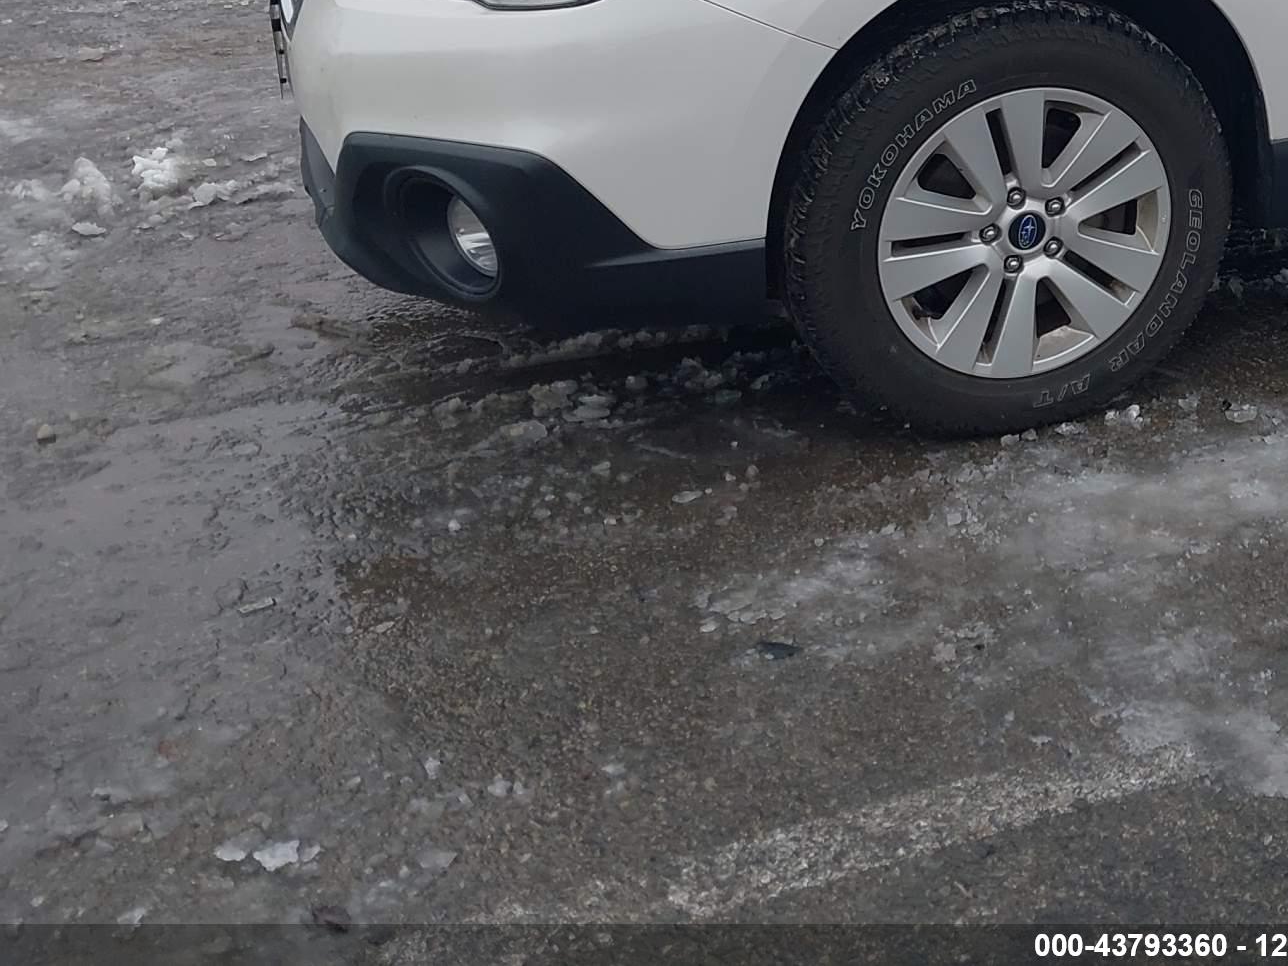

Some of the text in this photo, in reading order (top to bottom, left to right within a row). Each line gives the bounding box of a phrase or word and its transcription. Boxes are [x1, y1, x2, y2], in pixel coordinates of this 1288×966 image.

[850, 79, 977, 230] YOKOHAMA
[1033, 188, 1204, 408] GEOLANDAR A/T
